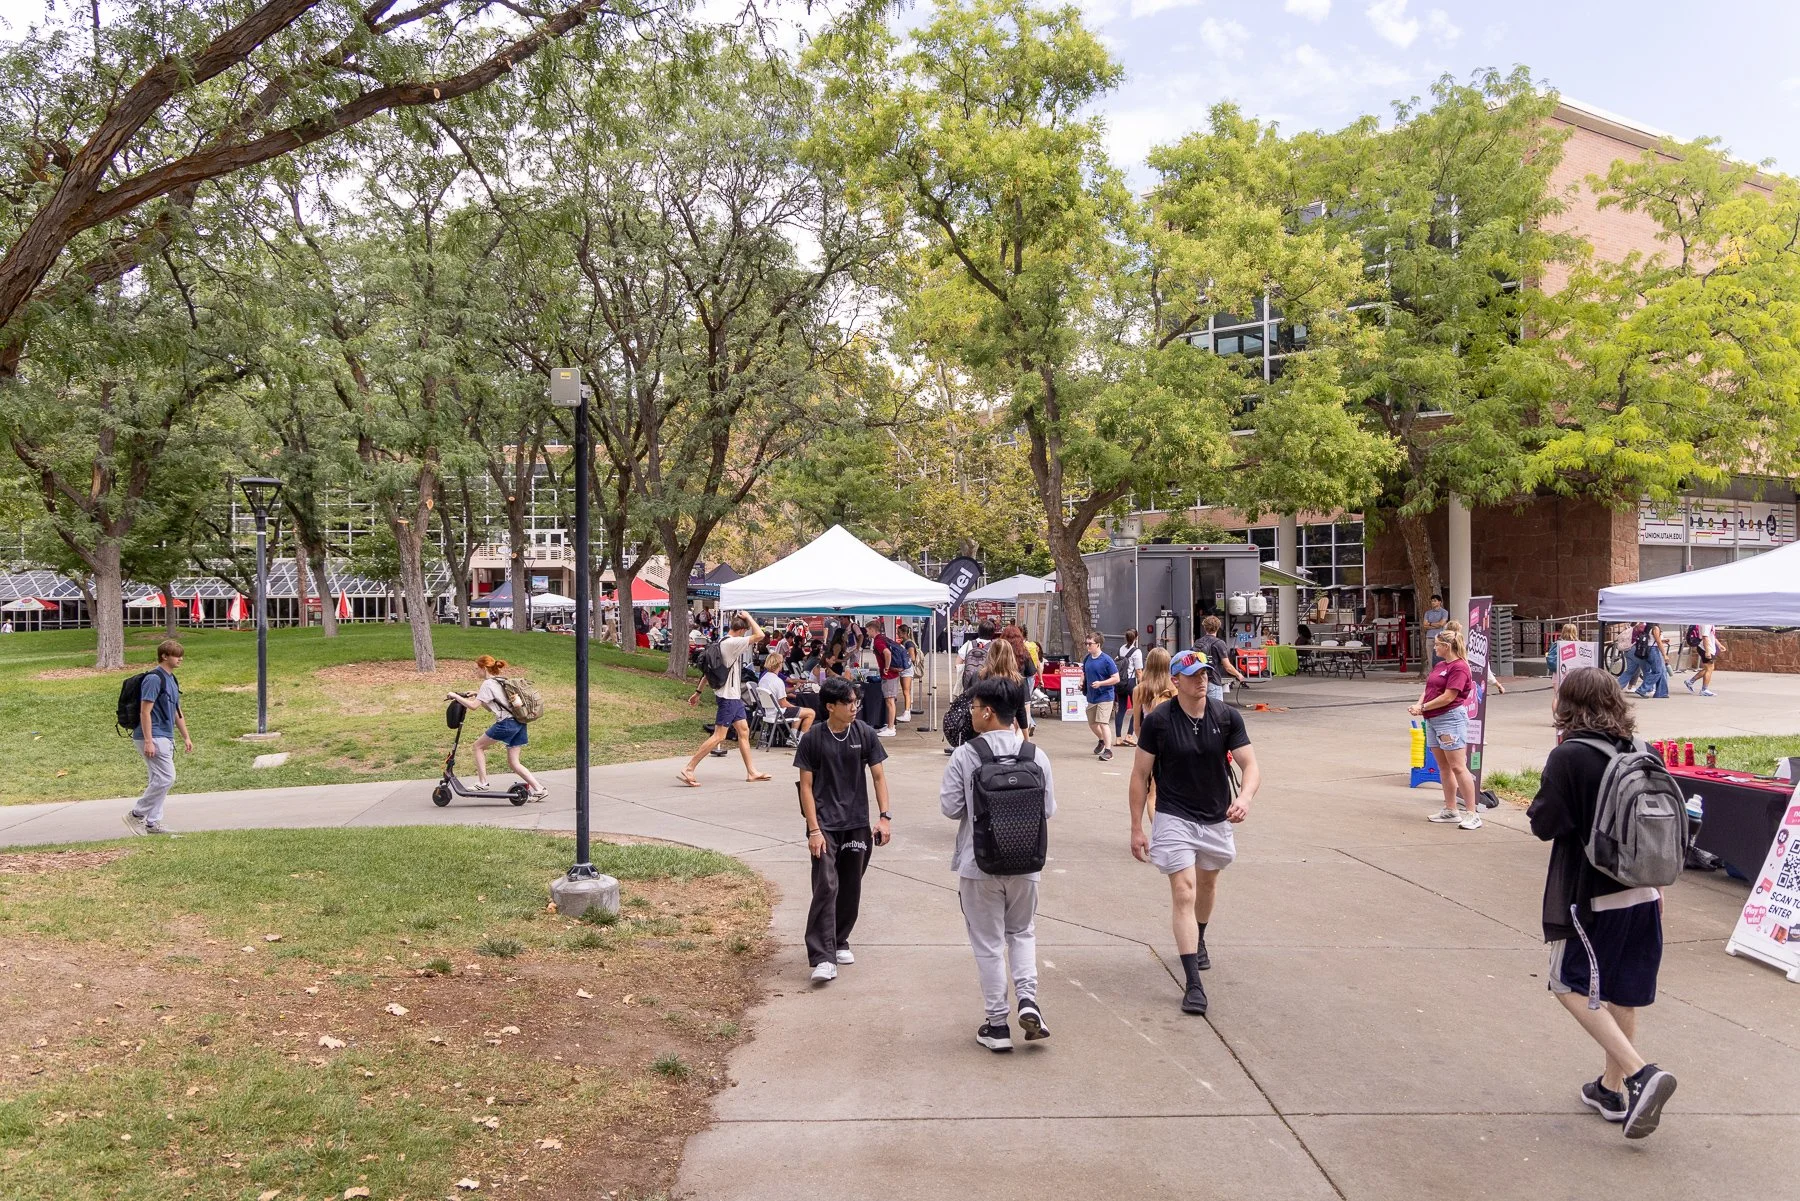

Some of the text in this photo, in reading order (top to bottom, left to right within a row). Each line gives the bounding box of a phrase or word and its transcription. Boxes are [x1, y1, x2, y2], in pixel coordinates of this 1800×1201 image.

[1645, 532, 1682, 540] UNION.UTAH.EDU
[1770, 891, 1793, 905] SCAN
[1768, 904, 1792, 919] ENTER
